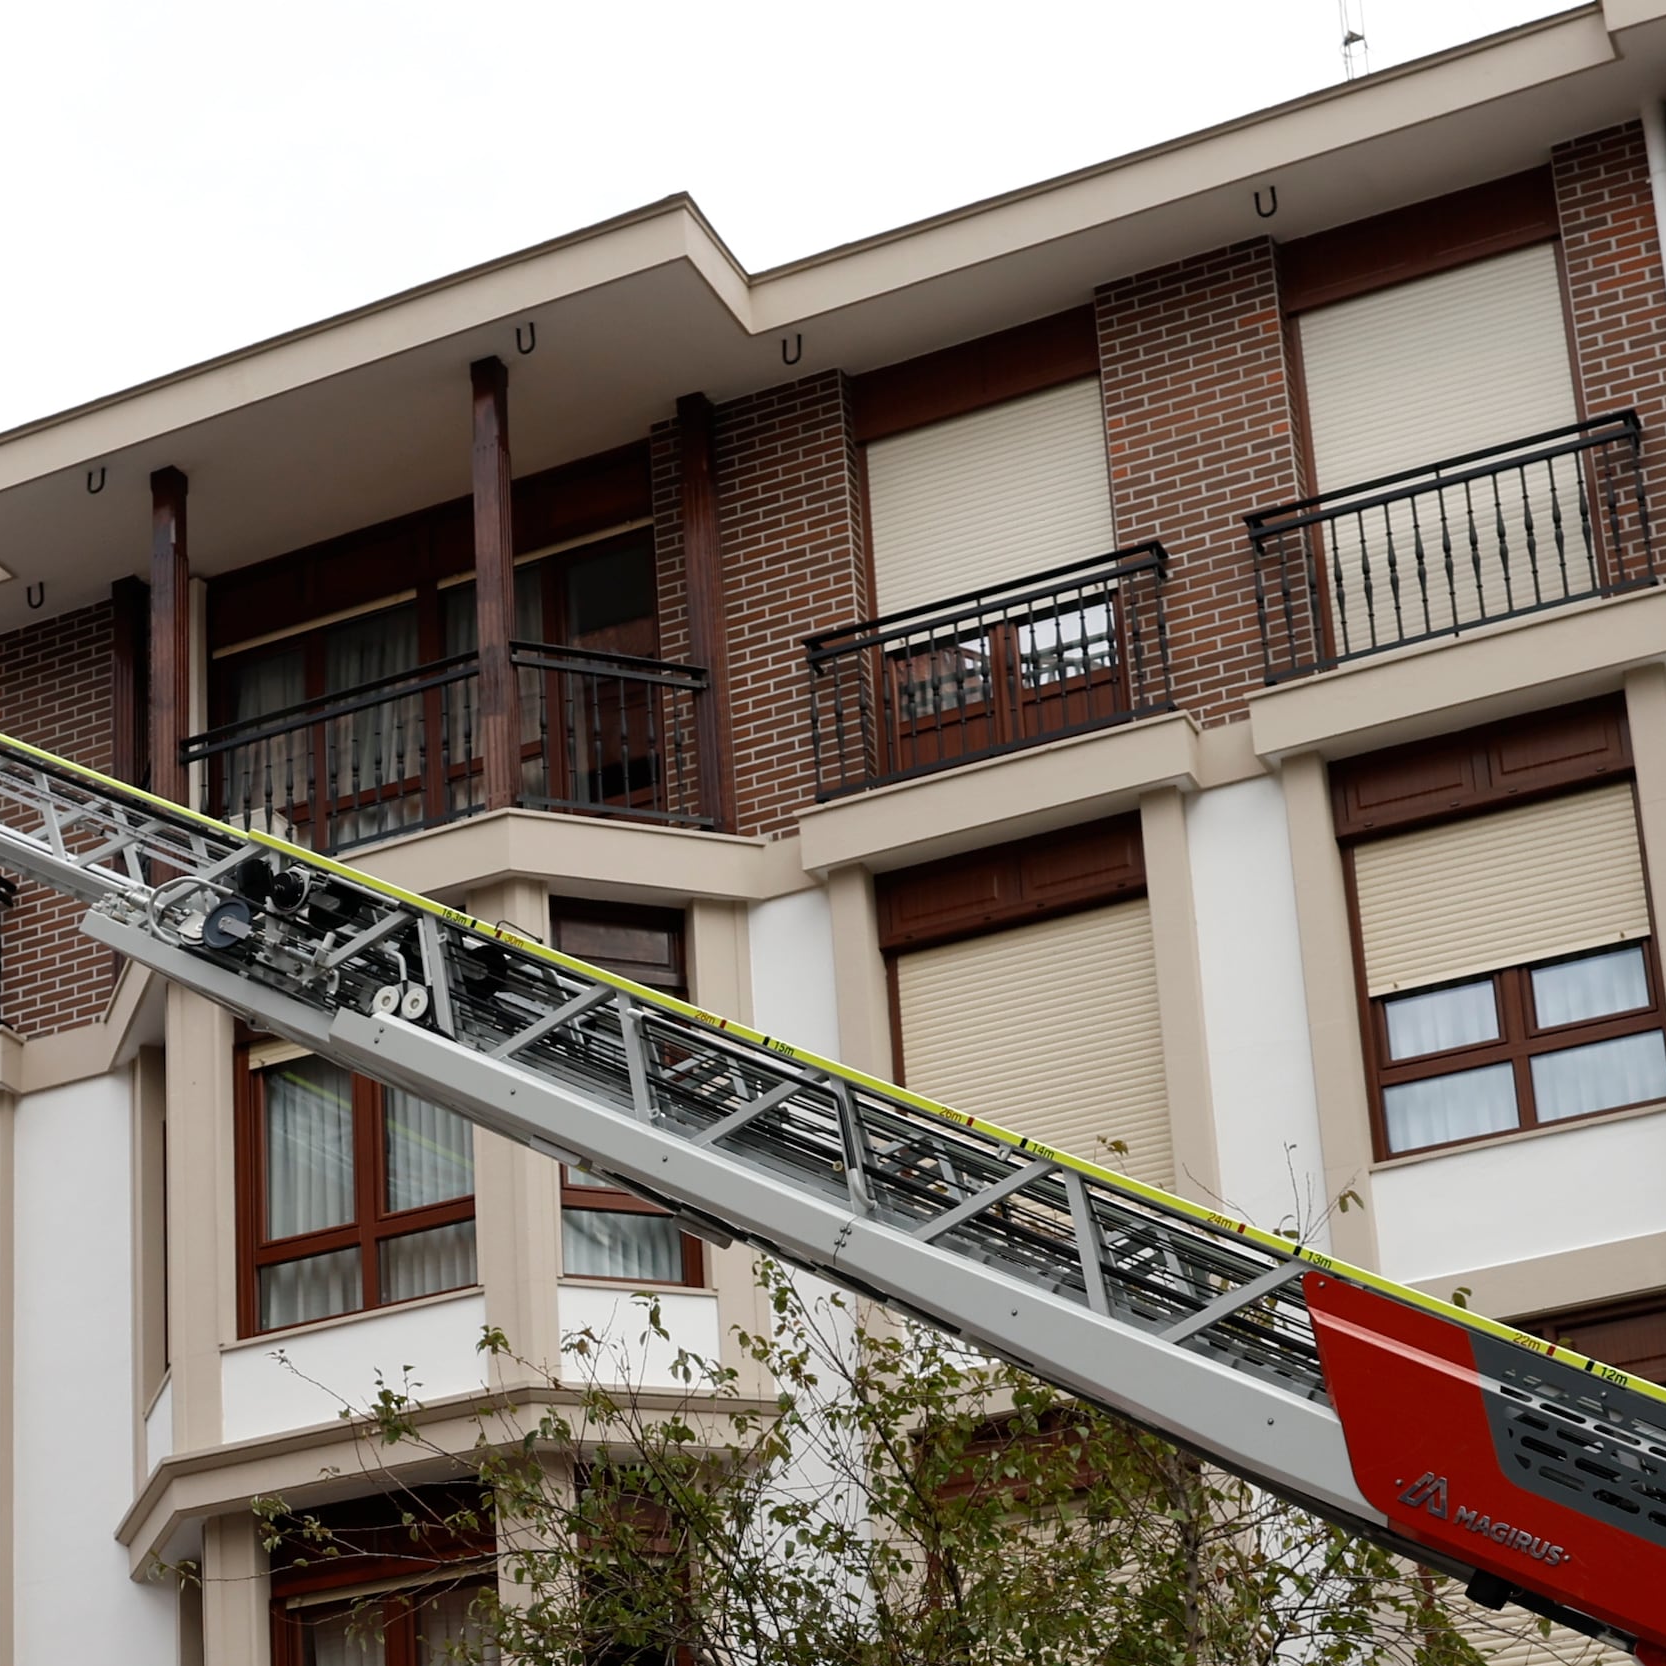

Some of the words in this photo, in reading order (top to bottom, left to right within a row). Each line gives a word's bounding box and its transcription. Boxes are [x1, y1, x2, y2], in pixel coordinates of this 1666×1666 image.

[504, 933, 525, 949] 30m
[694, 1008, 716, 1025] 28m
[774, 1041, 795, 1057] 15m
[939, 1106, 963, 1123] 26m
[1033, 1143, 1055, 1160] 14m
[1207, 1212, 1233, 1230] 24m
[1307, 1251, 1332, 1269] 13m
[1513, 1332, 1541, 1351] 22m
[1601, 1367, 1628, 1386] 12m
[1452, 1504, 1565, 1567] MAGIRUS
